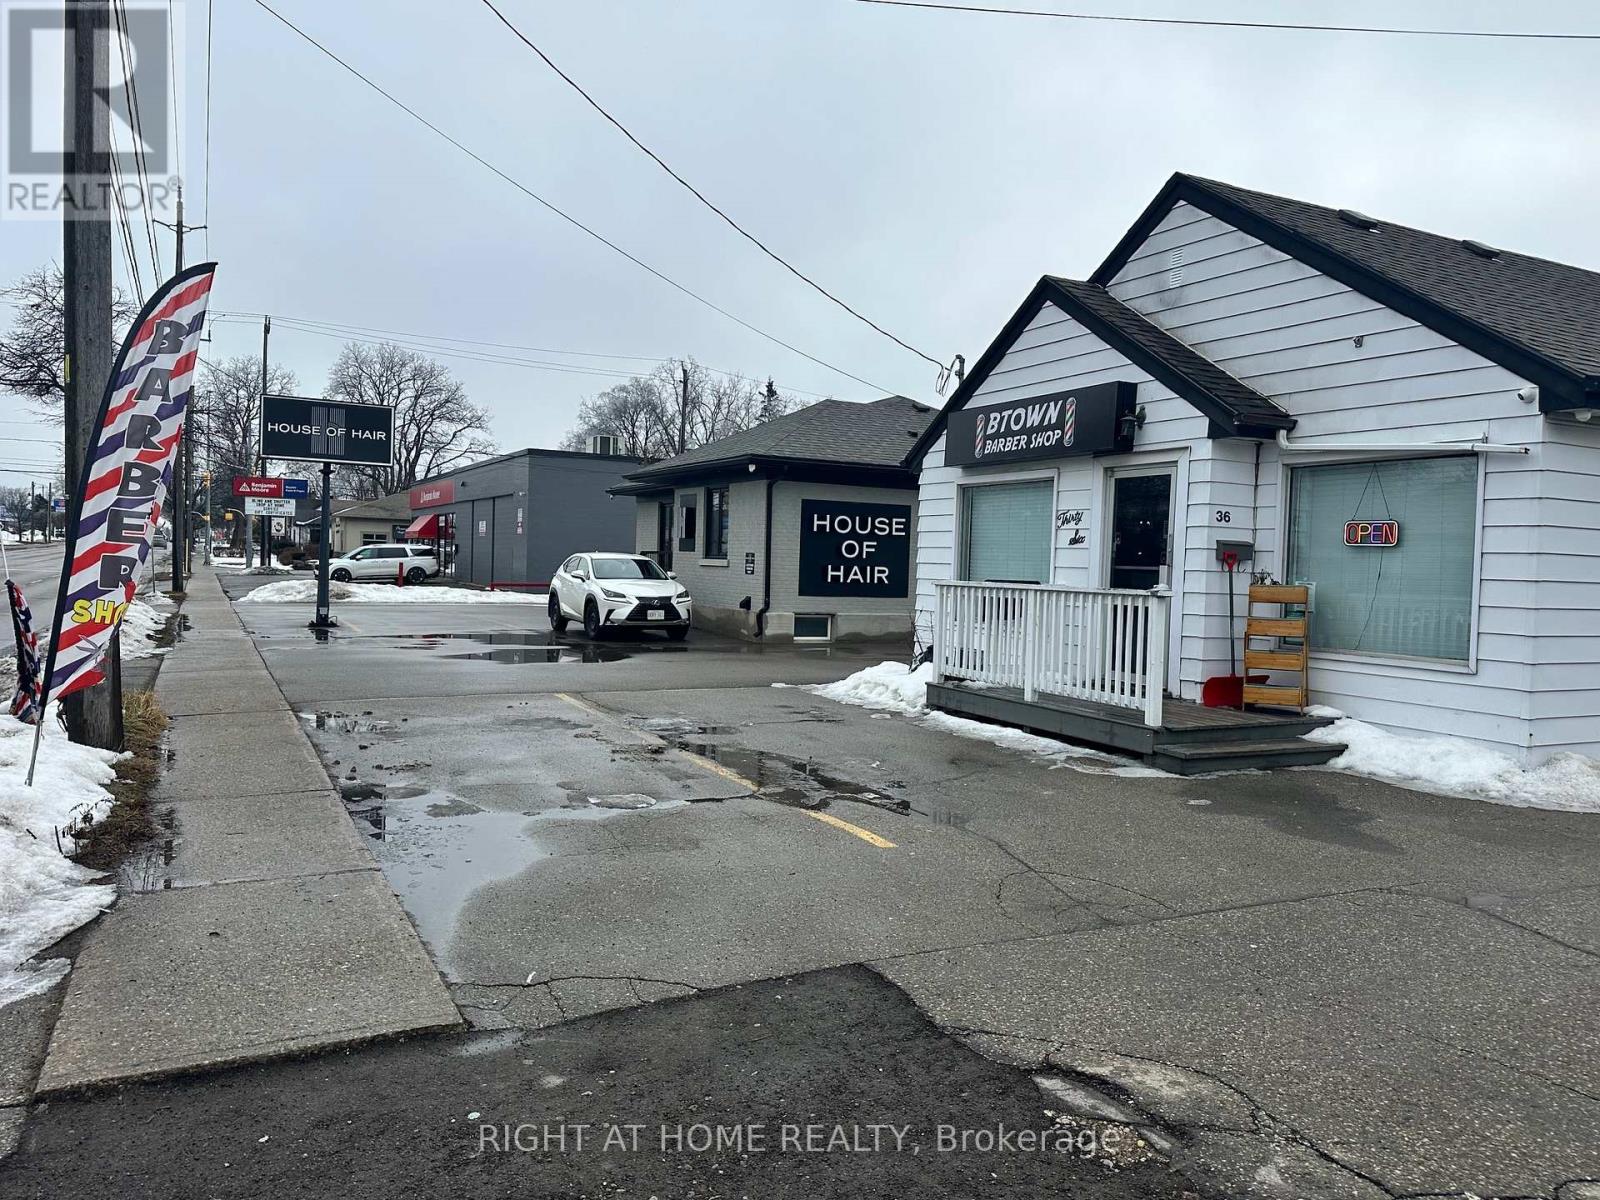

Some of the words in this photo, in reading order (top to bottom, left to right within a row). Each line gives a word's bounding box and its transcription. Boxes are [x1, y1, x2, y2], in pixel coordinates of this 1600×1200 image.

[986, 399, 1063, 435] BTOWN
[267, 422, 321, 436] HOUSE
[326, 427, 347, 437] OF
[351, 429, 387, 441] HAIR
[984, 435, 1027, 454] BARBER
[1030, 429, 1062, 448] SHOP
[98, 318, 190, 591] BARBER
[812, 514, 907, 536] HOUSE
[1057, 510, 1084, 529] Thirty
[1215, 511, 1231, 523] 36
[1067, 529, 1086, 546] Six
[1346, 523, 1396, 543] OPEN
[841, 540, 878, 559] OF
[827, 564, 889, 585] HAIR
